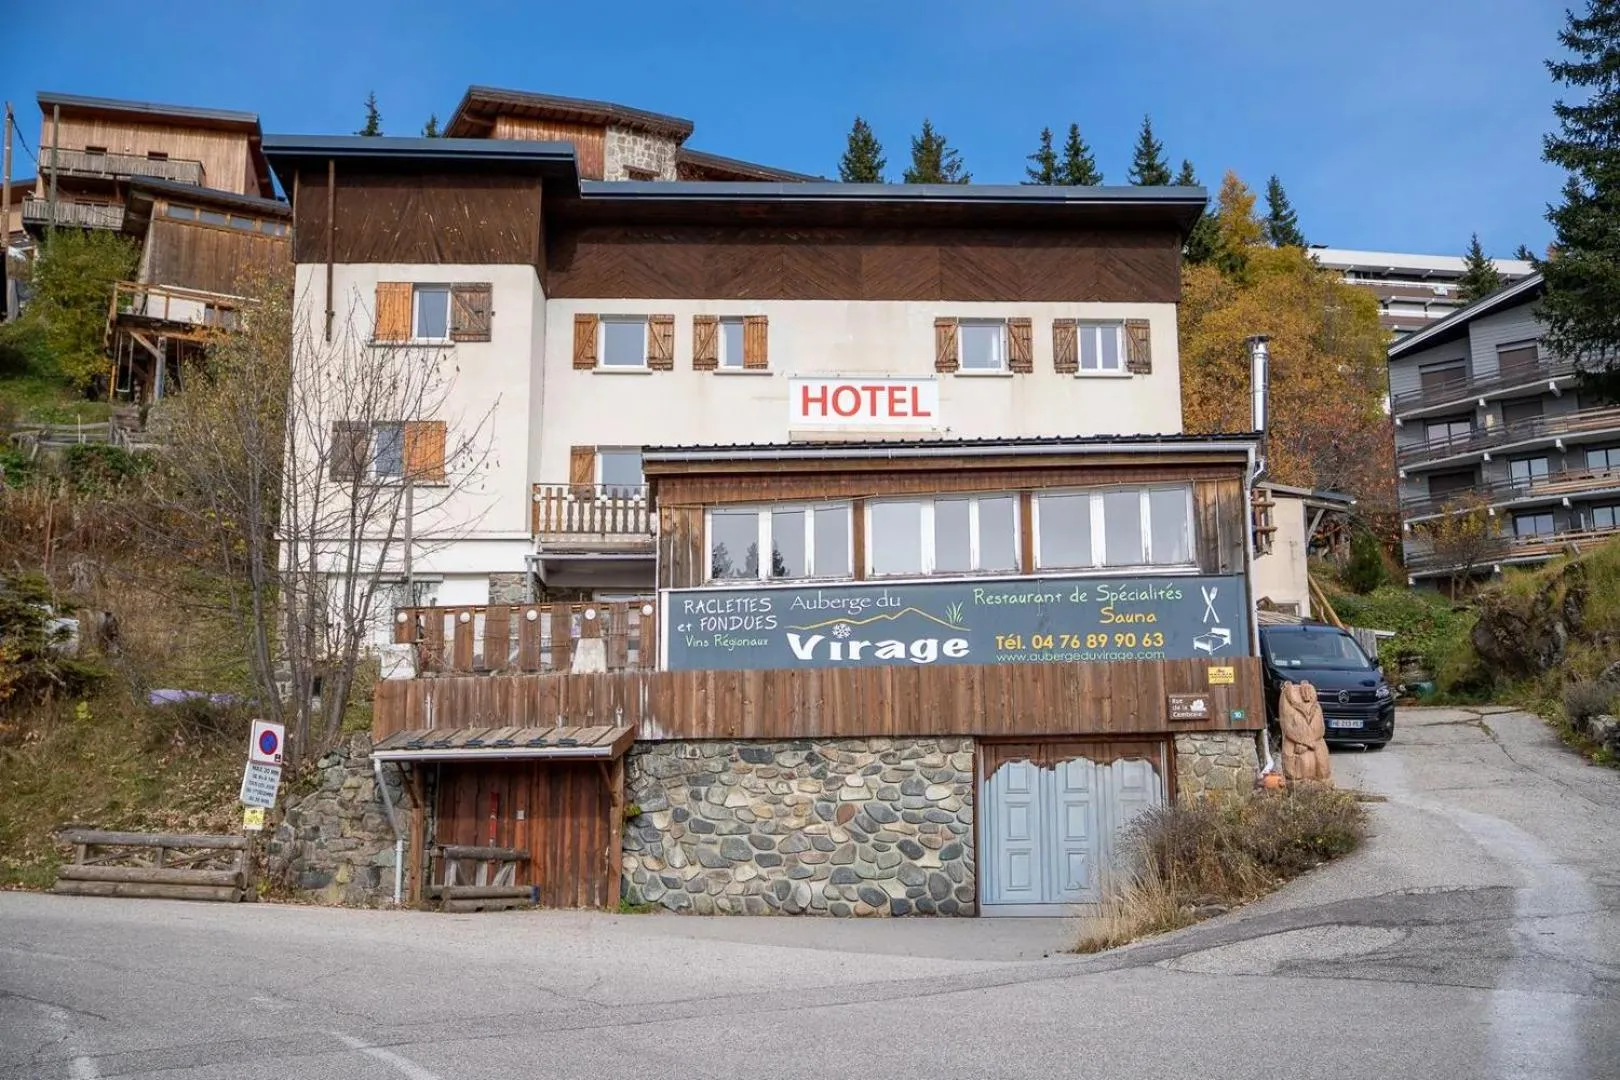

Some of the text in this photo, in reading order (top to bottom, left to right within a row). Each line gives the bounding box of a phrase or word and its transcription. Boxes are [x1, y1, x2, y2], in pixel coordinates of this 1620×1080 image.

[802, 385, 931, 417] HOTEL
[790, 589, 901, 615] Auberge du
[973, 582, 1183, 608] Restaurant de Spécialités
[684, 597, 772, 614] RACLETTES
[677, 615, 778, 632] et FONDUES
[1099, 606, 1157, 624] Sauna
[685, 633, 769, 651] Vins Régionaux
[786, 632, 970, 664] Virage
[995, 632, 1164, 650] Tél. 04 76 89 90 63
[996, 650, 1165, 663] www.aubergeduvirage.com
